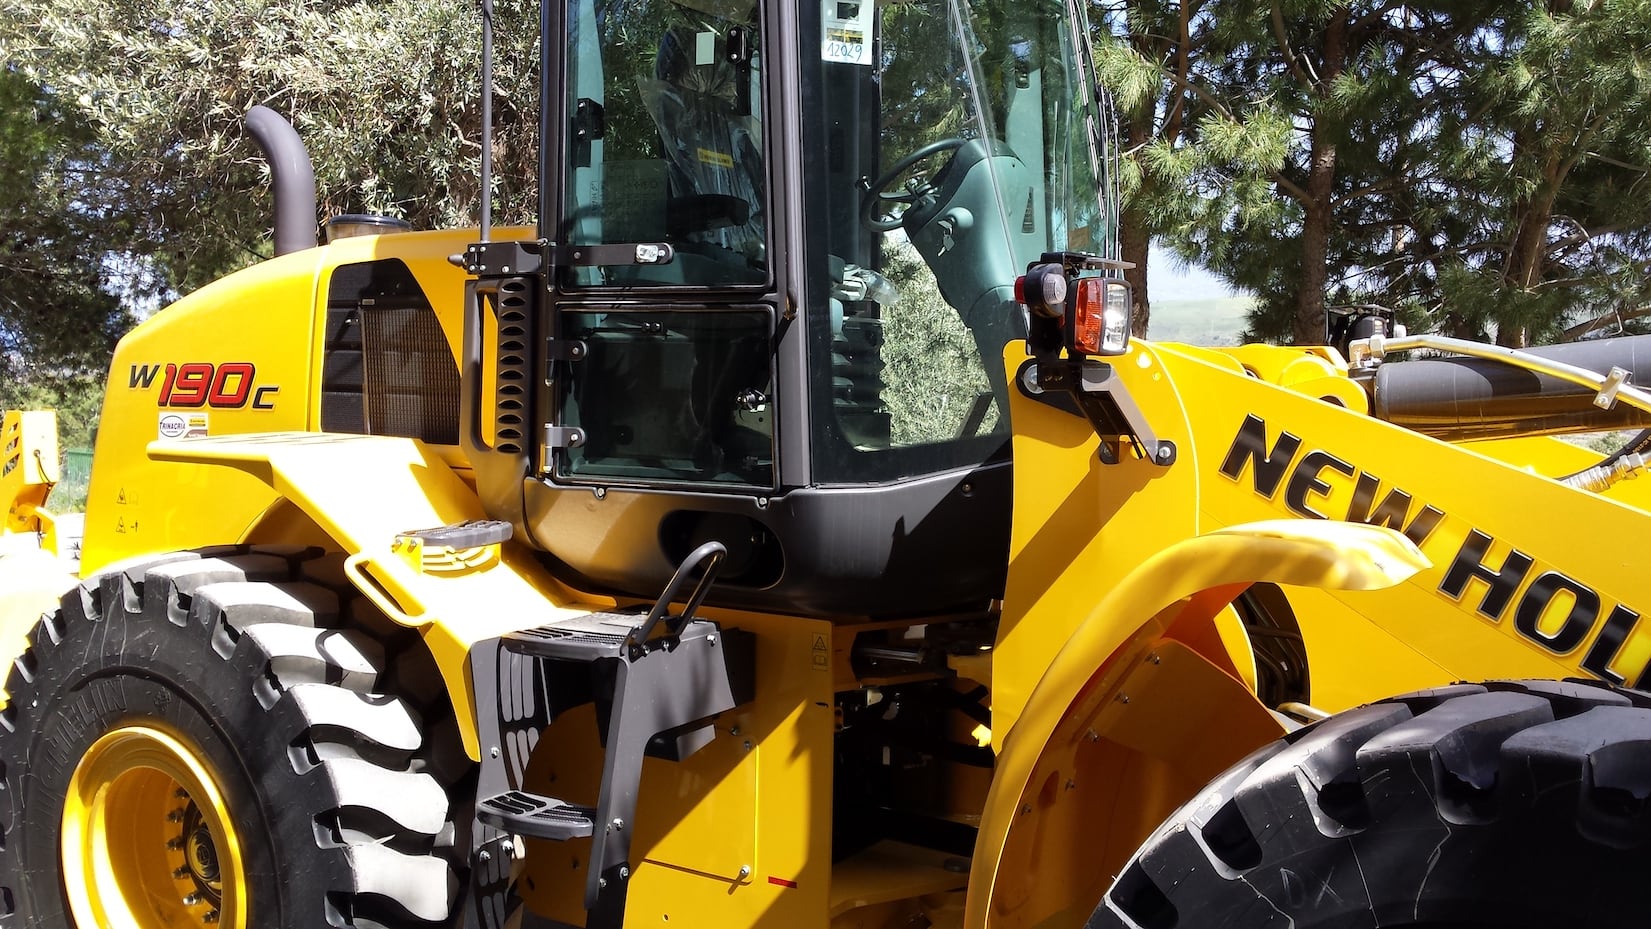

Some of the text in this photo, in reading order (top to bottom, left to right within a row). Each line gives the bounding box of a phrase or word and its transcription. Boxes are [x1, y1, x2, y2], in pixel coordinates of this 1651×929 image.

[827, 42, 863, 62] 12029
[159, 421, 186, 430] TRINACRIA
[1218, 413, 1651, 690] NEW HOL
